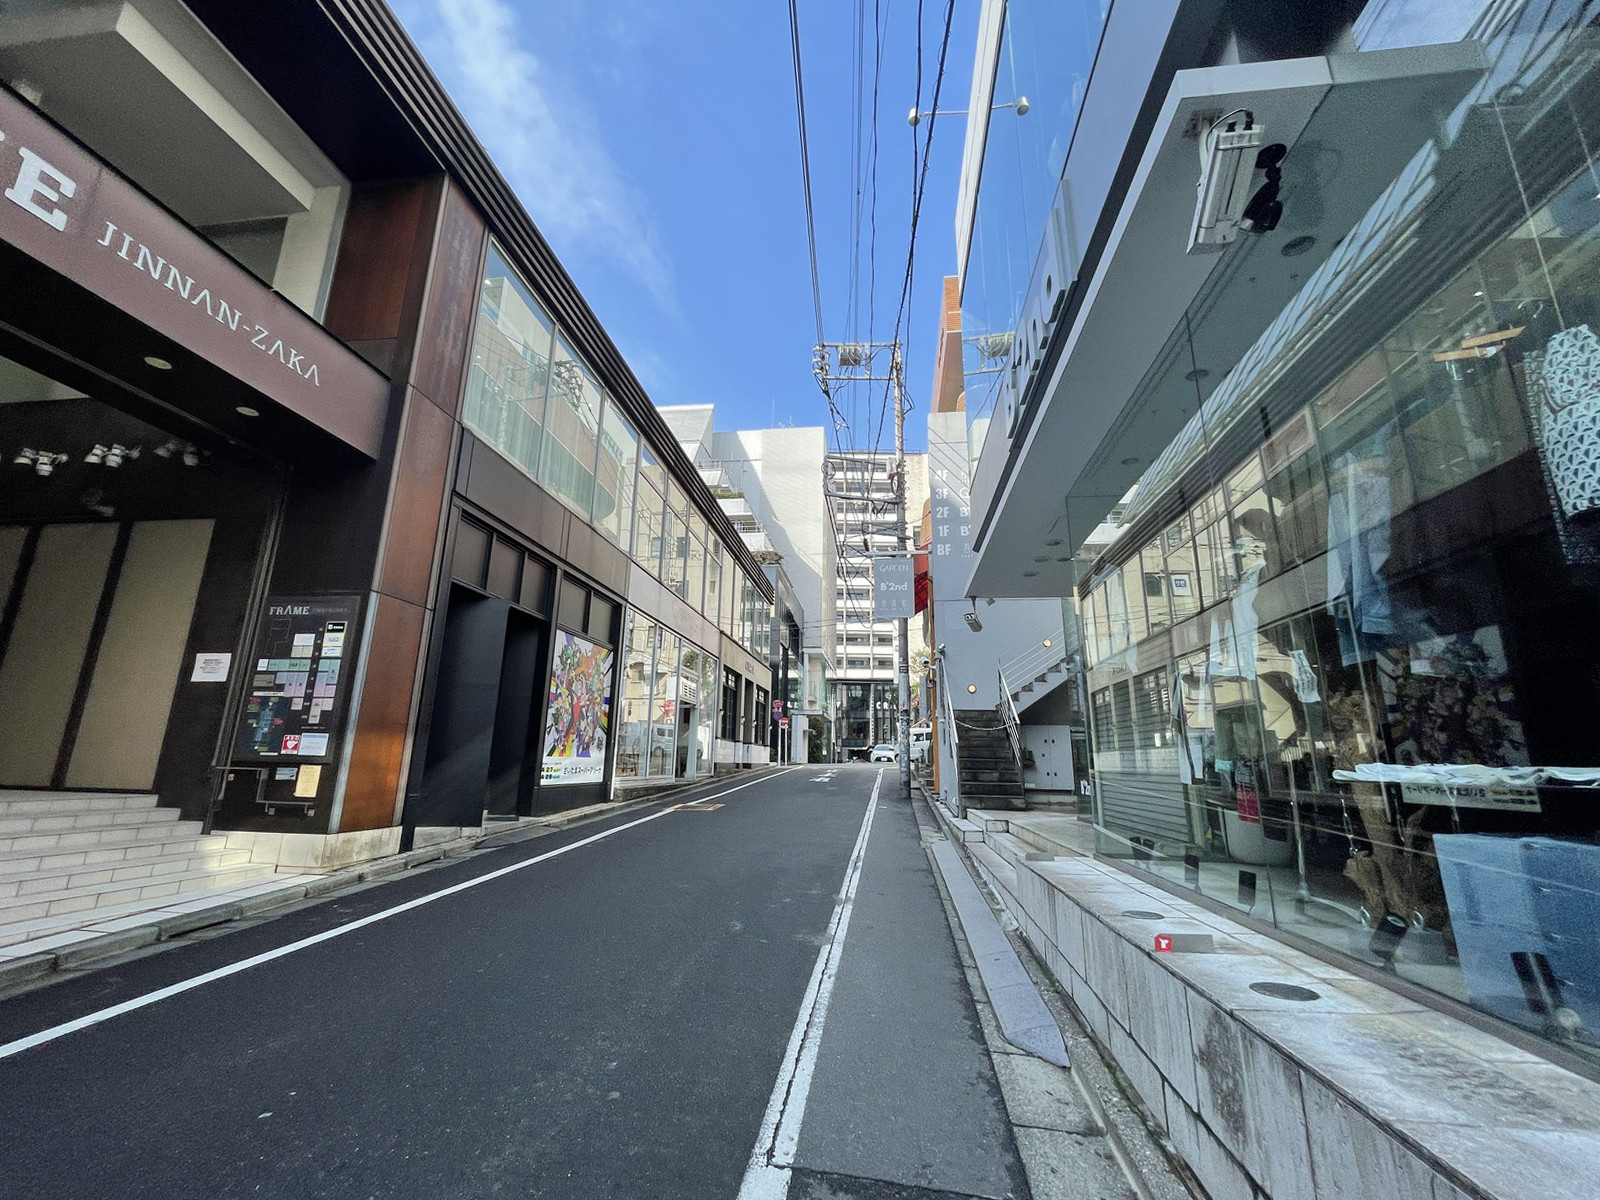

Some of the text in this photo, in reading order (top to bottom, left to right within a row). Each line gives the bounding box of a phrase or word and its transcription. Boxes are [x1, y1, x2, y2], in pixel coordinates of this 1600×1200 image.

[0, 131, 320, 387] E JINNAN-ZAKA
[935, 488, 949, 499] 3F
[936, 506, 949, 518] 2F
[937, 525, 950, 537] 1F
[937, 544, 951, 556] BF
[880, 581, 908, 591] B'2nd
[269, 604, 310, 615] FRAME
